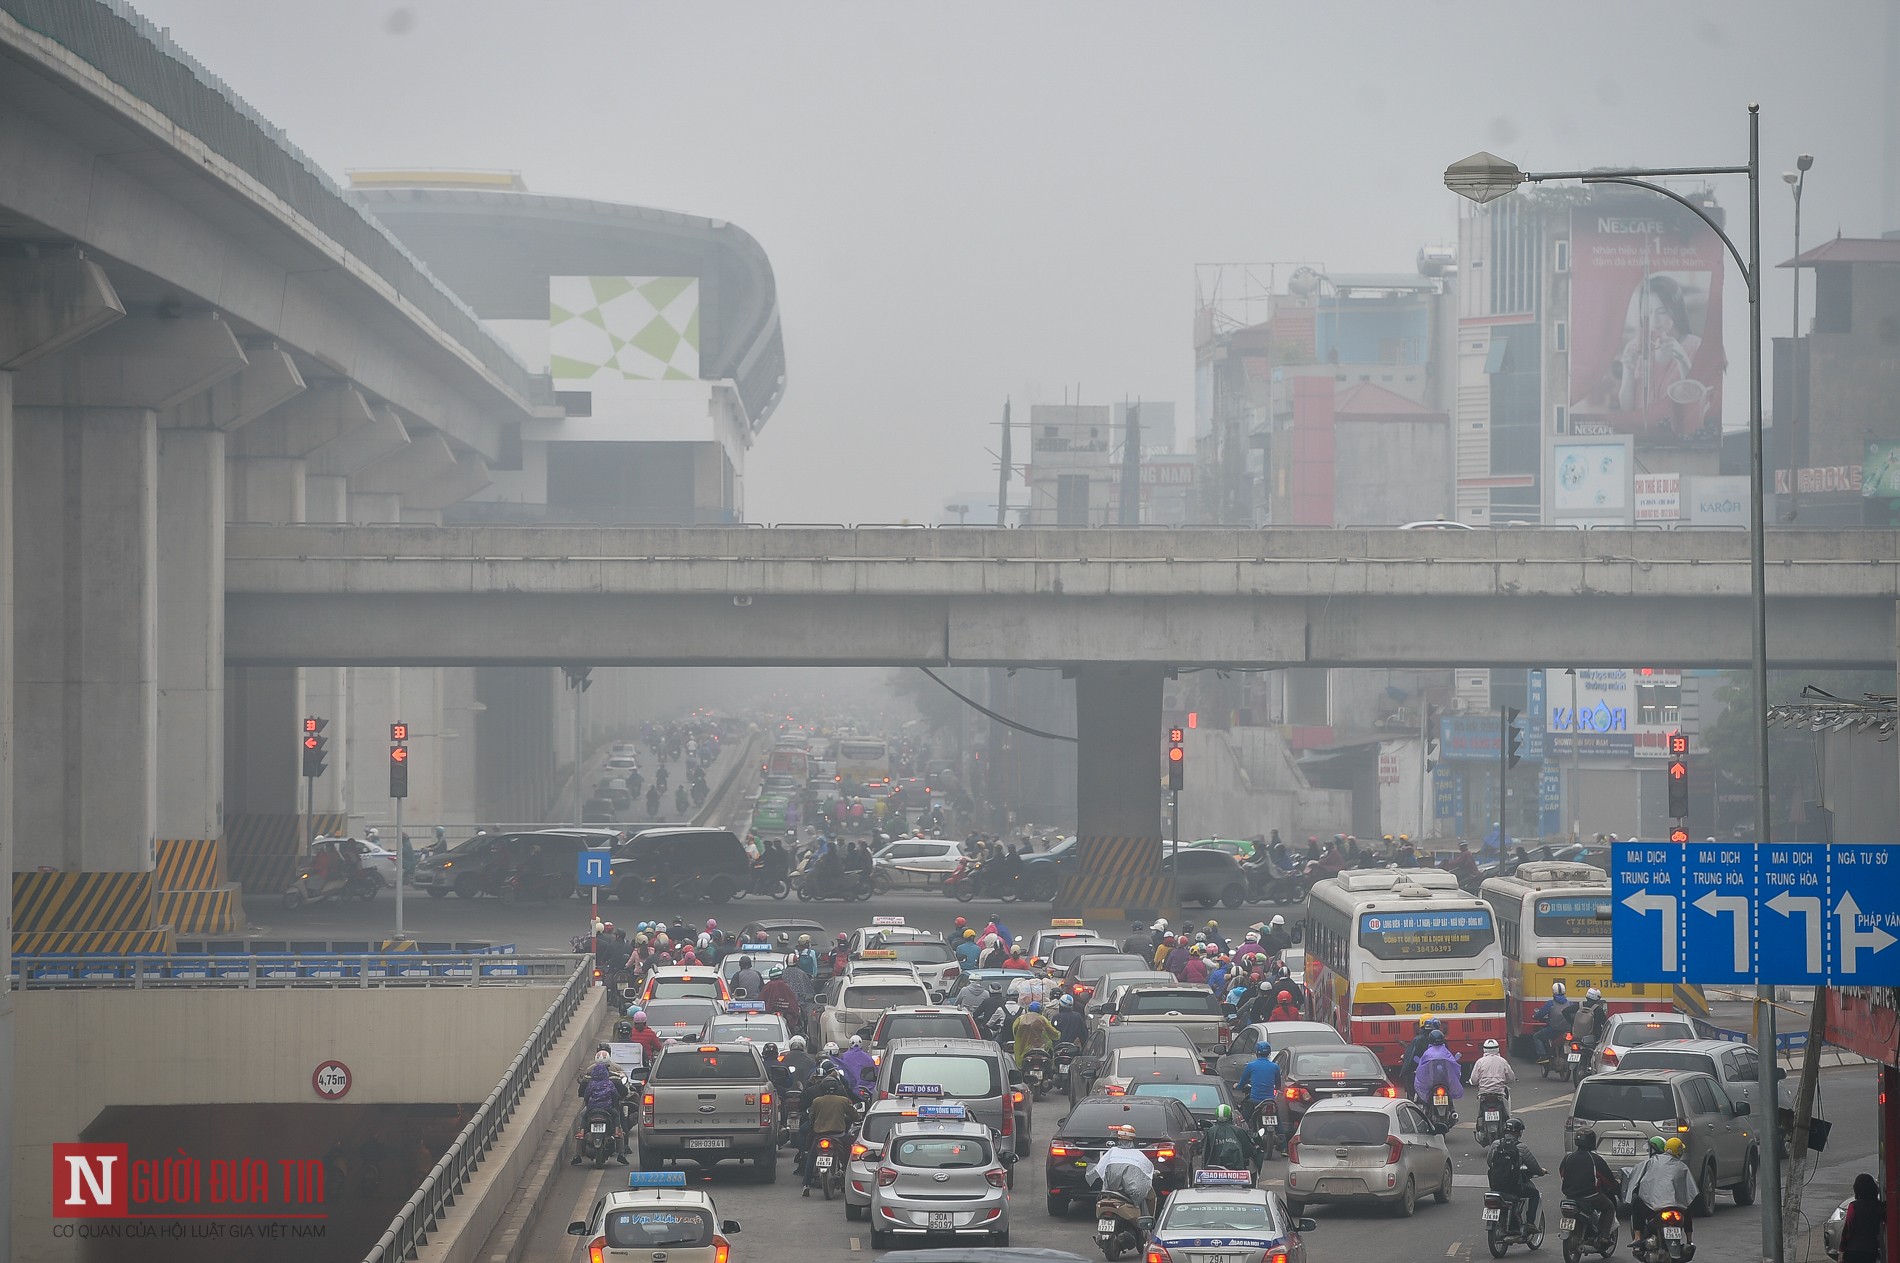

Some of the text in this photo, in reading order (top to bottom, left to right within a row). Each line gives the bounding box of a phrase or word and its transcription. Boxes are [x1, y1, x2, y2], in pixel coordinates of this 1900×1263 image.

[1161, 467, 1191, 483] NAM
[1627, 851, 1667, 866] MAI DỊCH
[1699, 851, 1741, 866] MAI DỊCH
[1772, 852, 1813, 866] MAI DỊCH
[1837, 849, 1888, 865] NGÃ TƯ SỞ
[1621, 869, 1671, 884] TRUNG HÒA
[1693, 869, 1744, 885] TRUNG HÒA
[1766, 870, 1818, 885] TRUNG HÒA
[1858, 911, 1882, 926] PHÁP
[1576, 979, 1591, 988] 29B
[1406, 1003, 1458, 1012] 29B 066.93
[318, 1074, 345, 1086] 4,75m
[1617, 1139, 1630, 1147] 29A
[934, 1212, 948, 1221] 30A
